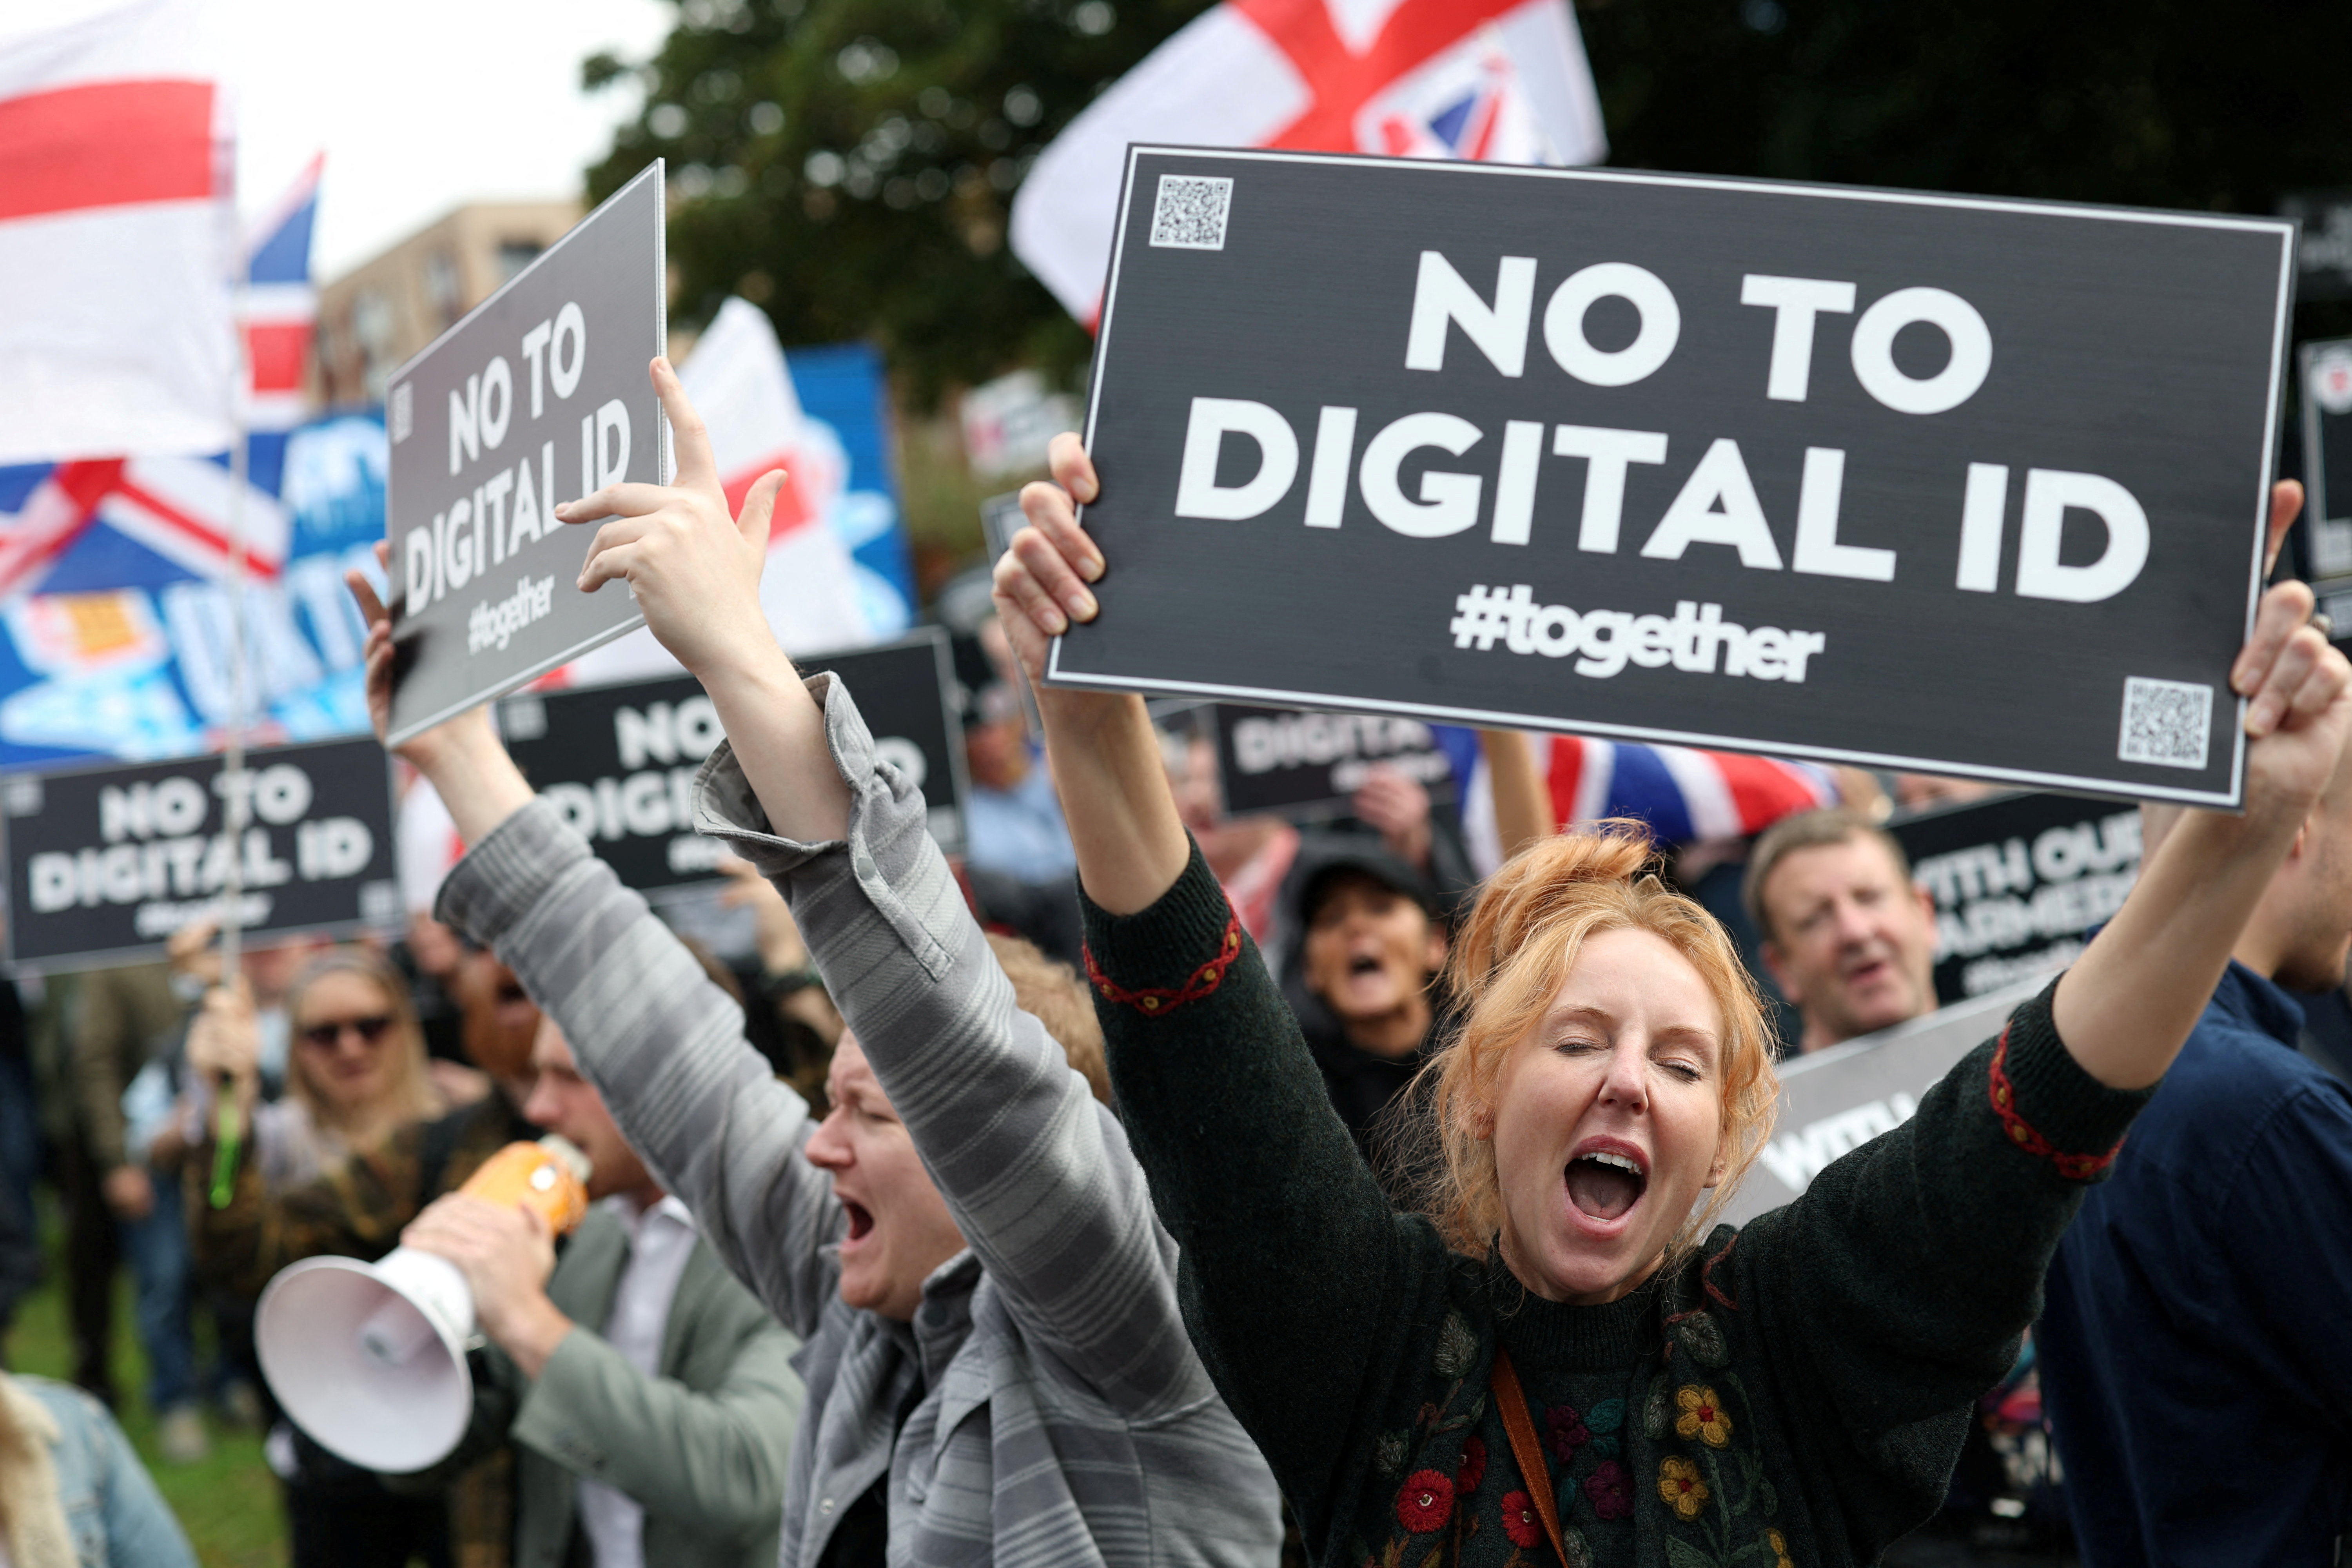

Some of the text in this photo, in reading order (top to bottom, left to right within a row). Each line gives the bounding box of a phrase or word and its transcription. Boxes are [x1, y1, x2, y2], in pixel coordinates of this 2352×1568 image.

[1404, 250, 1993, 415] NO TO
[449, 356, 512, 476] NO
[522, 301, 586, 419] TO
[405, 440, 565, 617] DIGITAL
[581, 398, 631, 498] ID
[1174, 396, 2150, 603] DIGITAL ID
[467, 574, 555, 655] #together
[1450, 584, 1826, 682] #together
[615, 695, 726, 771] NO
[101, 762, 312, 842] NO TO
[29, 816, 374, 913] DIGITAL ID
[1914, 837, 2034, 906] ITH
